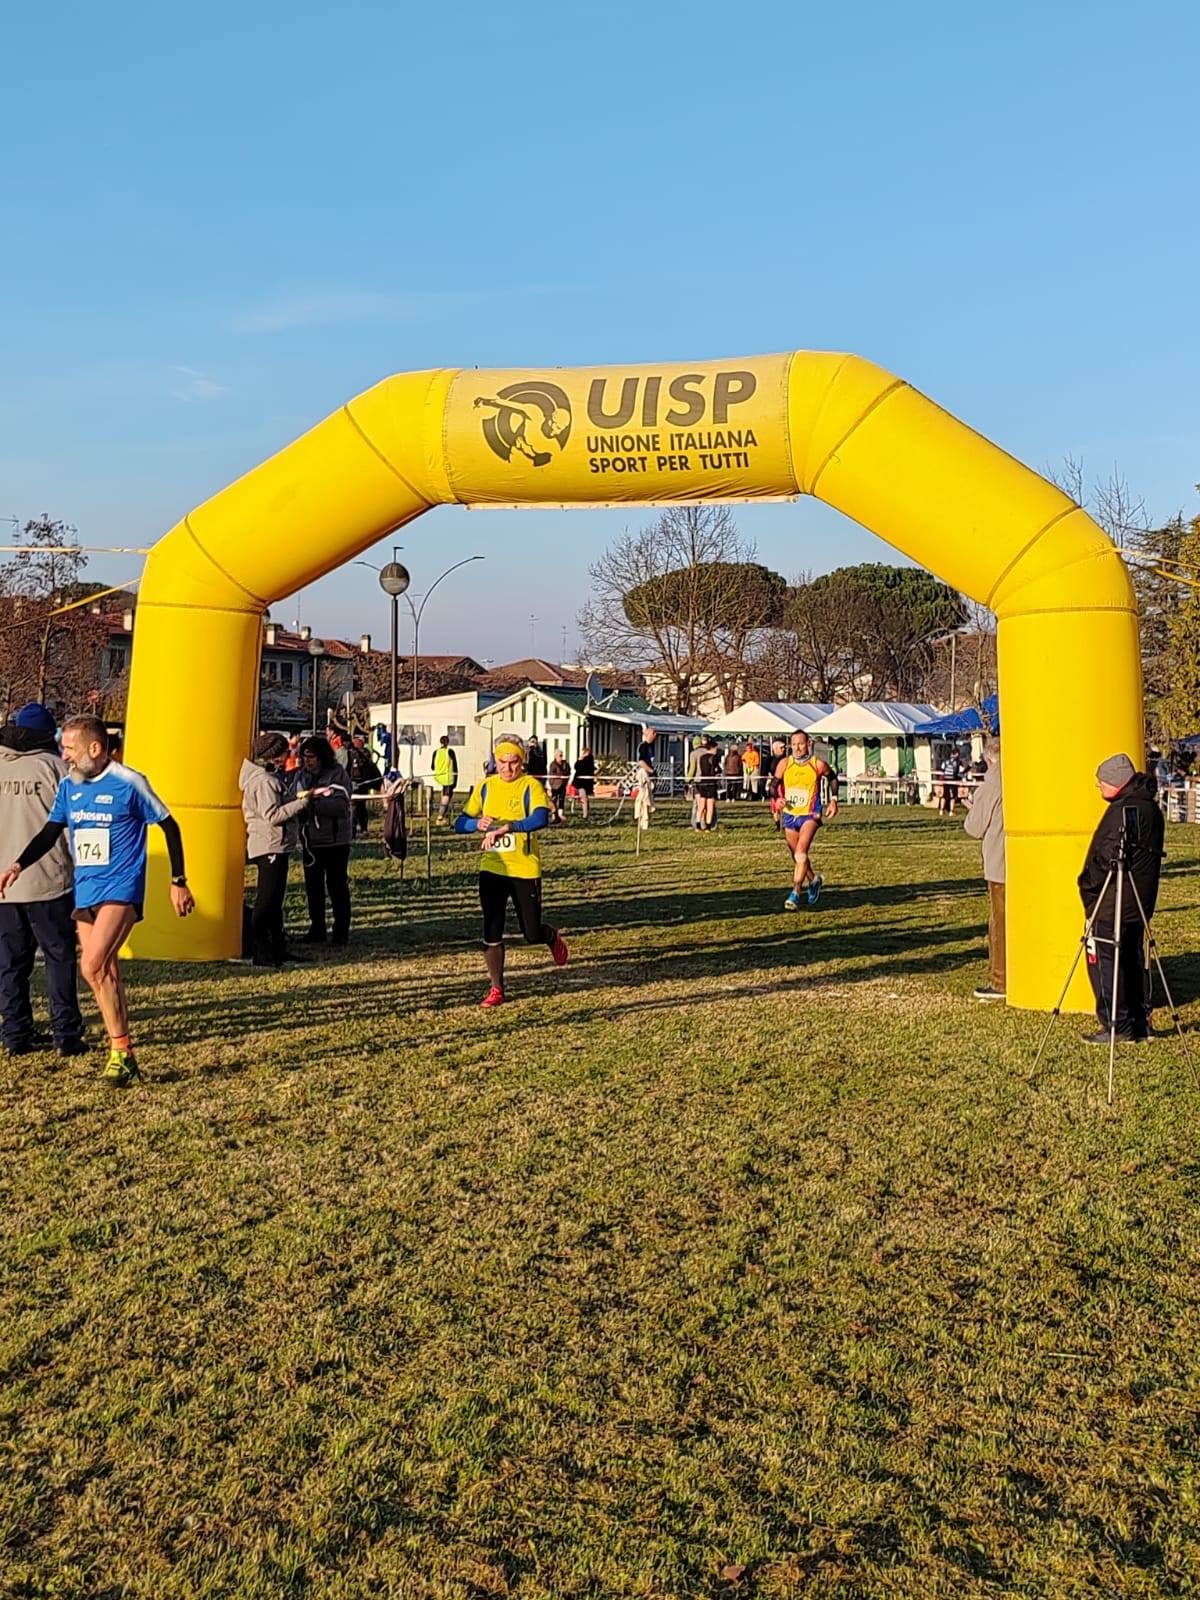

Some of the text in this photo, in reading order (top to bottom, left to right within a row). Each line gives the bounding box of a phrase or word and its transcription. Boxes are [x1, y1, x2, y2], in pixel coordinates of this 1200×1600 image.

[587, 371, 756, 429] UISP
[587, 429, 757, 453] UNIONE ITALIANA
[589, 451, 750, 473] SPORT PER TUTTI
[77, 842, 102, 860] 174
